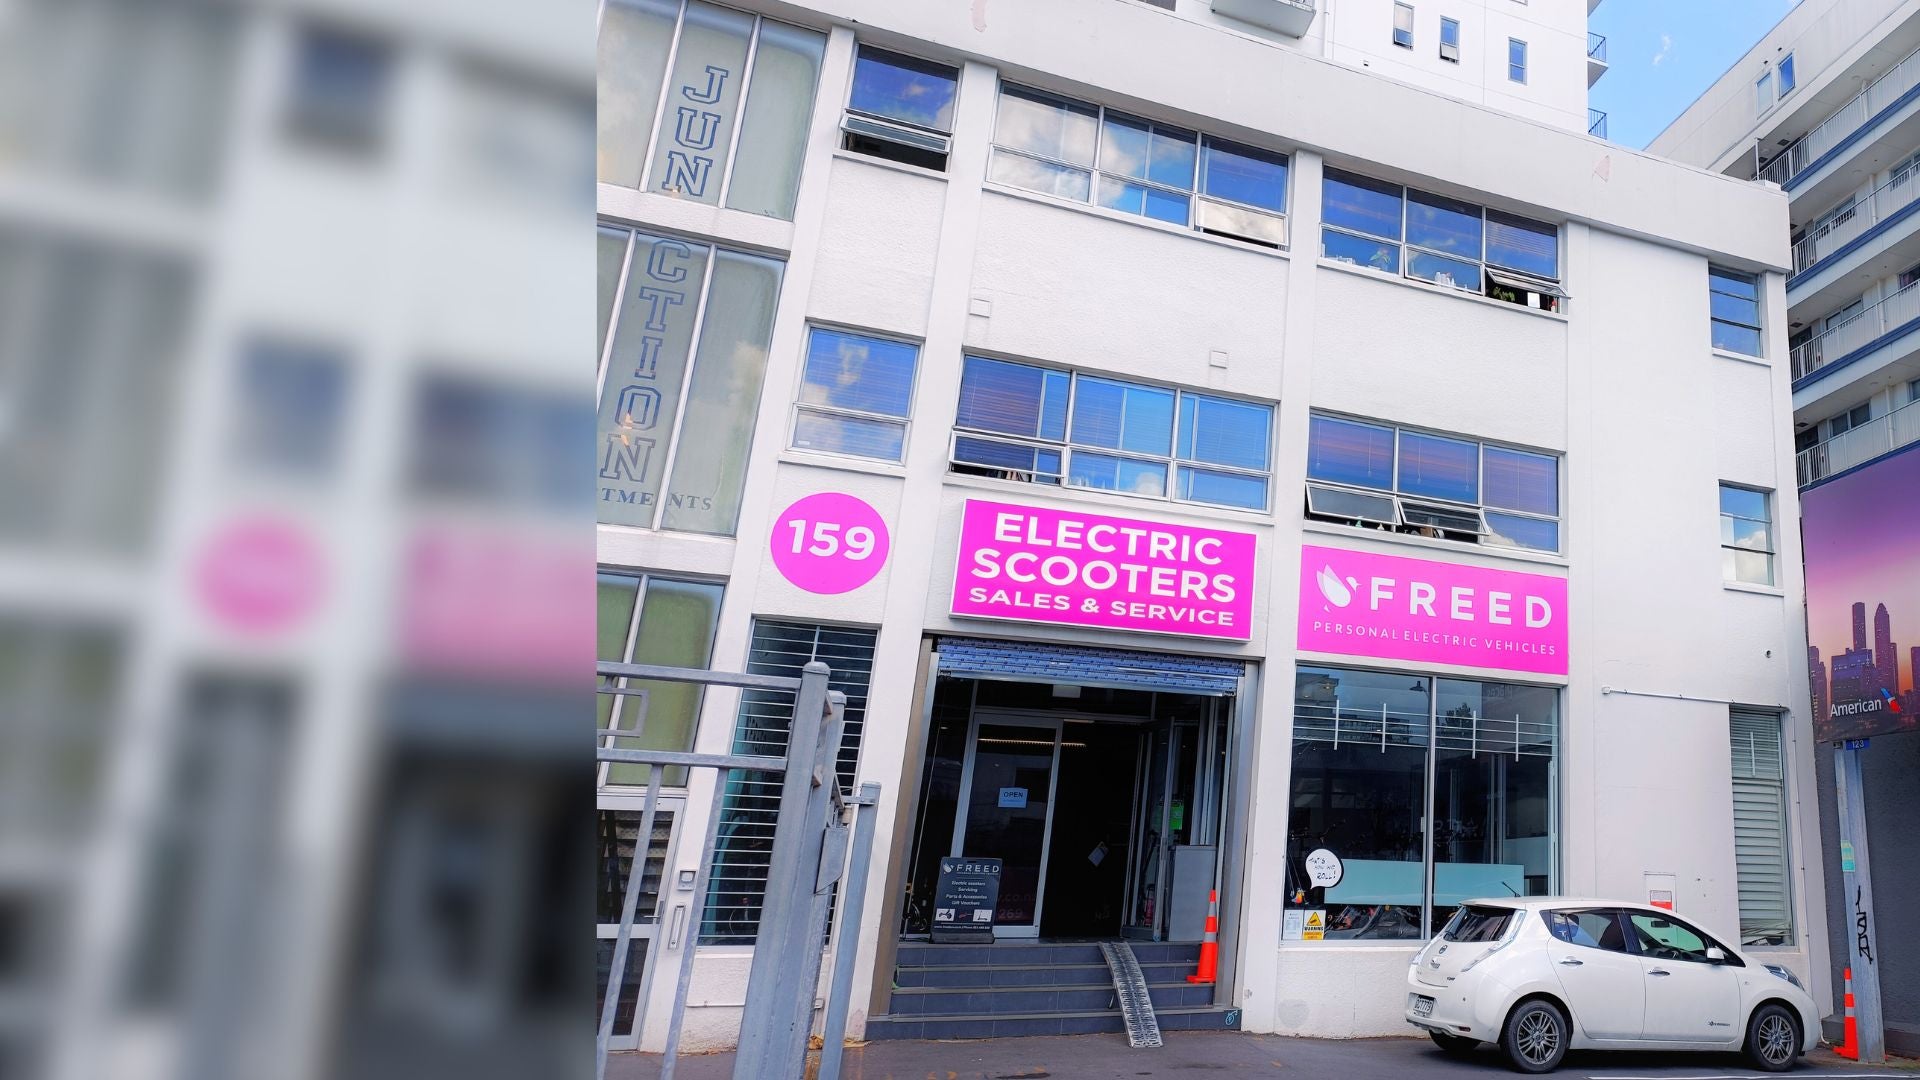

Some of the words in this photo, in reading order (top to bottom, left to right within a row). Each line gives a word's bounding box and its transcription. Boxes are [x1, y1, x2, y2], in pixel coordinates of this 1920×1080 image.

[787, 518, 877, 561] 159
[995, 512, 1223, 566] ELECTRIC
[971, 547, 1236, 603] SCOOTERS
[969, 587, 1070, 611] SALES
[1081, 597, 1100, 613] &
[1111, 602, 1235, 626] SERVICE
[1370, 576, 1552, 628] FREED
[1313, 621, 1398, 640] PERSONAL
[1404, 630, 1477, 648] ELECTRIC
[1485, 639, 1556, 656] VEHICLES
[1830, 699, 1882, 717] American
[1852, 739, 1865, 749] 123
[956, 864, 1000, 873] FREED
